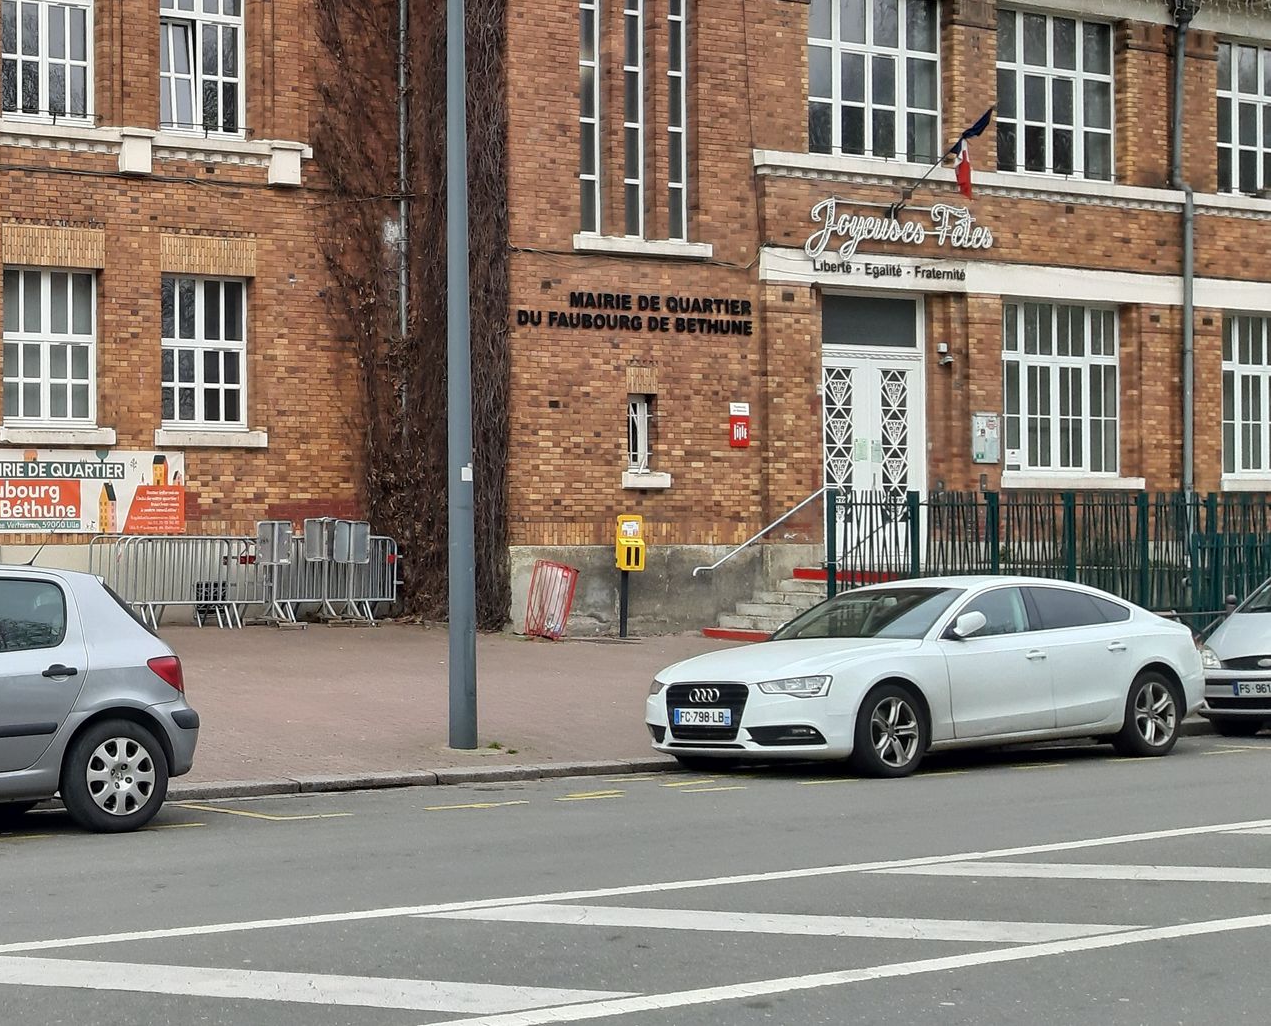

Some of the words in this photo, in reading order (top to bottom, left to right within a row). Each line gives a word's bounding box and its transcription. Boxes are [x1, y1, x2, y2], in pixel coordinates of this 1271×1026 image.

[805, 196, 925, 261] Joyeuses
[931, 203, 994, 249] Fêtes
[813, 259, 852, 274] Liberté
[864, 262, 902, 278] Egalité
[914, 265, 966, 281] Fraternité
[570, 291, 632, 311] MAIRIE
[638, 295, 661, 312] DE
[666, 296, 752, 316] QUARTIER
[517, 309, 542, 326] DU
[548, 311, 643, 331] FAUBOURG
[648, 316, 670, 332] DE
[675, 317, 753, 335] BETHUNE
[29, 463, 47, 477] DE
[50, 463, 123, 478] QUARTIER
[0, 500, 76, 518] Béthune
